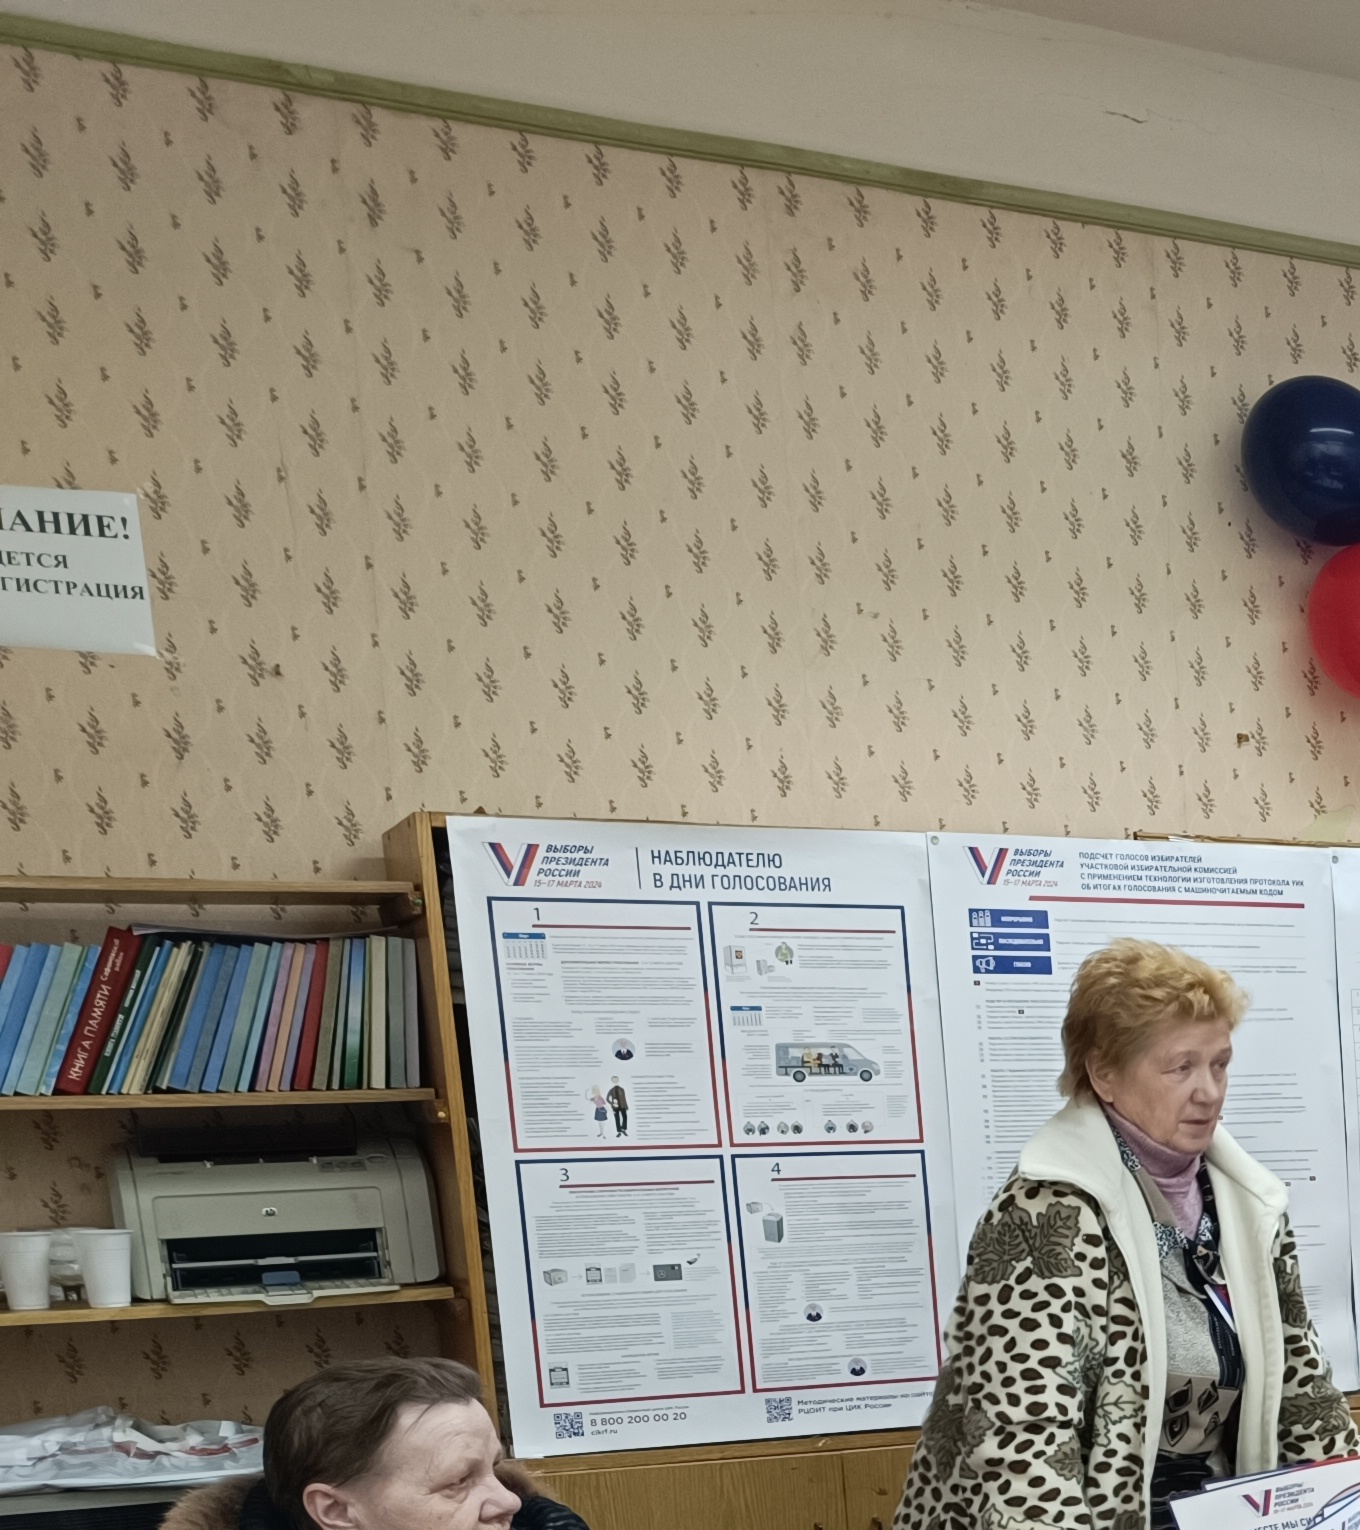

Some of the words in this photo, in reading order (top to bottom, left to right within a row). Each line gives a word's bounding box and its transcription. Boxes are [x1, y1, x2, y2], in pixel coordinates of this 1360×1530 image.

[0, 576, 145, 600] ГИСТРАЦИЯ
[545, 843, 594, 855] ВЫБОРЫ
[1014, 848, 1052, 858] ВЫБОРЫ
[541, 856, 610, 868] ПРЕЗИДЕНТА
[650, 849, 783, 870] НАБЛЮДАТЕЛЮ
[1010, 858, 1065, 869] ПРЕЗИДЕНТА
[1079, 852, 1113, 861] ПОДСЧЕТ
[1115, 853, 1149, 862] ГОЛОСОВ
[1151, 854, 1202, 863] ИЗБИРАТЕЛЕЙ
[536, 867, 581, 879] РОССИИ
[1005, 869, 1041, 878] РОССИИ
[1080, 862, 1129, 871] УЧАСТКОВОЙ
[1131, 864, 1192, 873] ИЗБИРАТЕЛЬНОЙ
[1194, 866, 1237, 875] КОМИССИЕЙ
[556, 879, 582, 888] МАРТА
[653, 873, 664, 888] В
[669, 873, 705, 891] ДНИ
[711, 875, 832, 893] ГОЛОСОВАНИЯ
[1124, 885, 1176, 893] ГОЛОСОВАНИЯ
[749, 912, 760, 925] 2
[68, 1040, 93, 1081] КНИГА
[84, 984, 112, 1038] ПАМЯТИ
[770, 1162, 781, 1175] 4
[559, 1168, 570, 1182] 3
[590, 1418, 597, 1427] 8
[601, 1417, 624, 1426] 800
[627, 1414, 650, 1424] 200
[653, 1413, 669, 1422] 00
[673, 1412, 687, 1420] 20
[1281, 1520, 1299, 1530] МЫ
